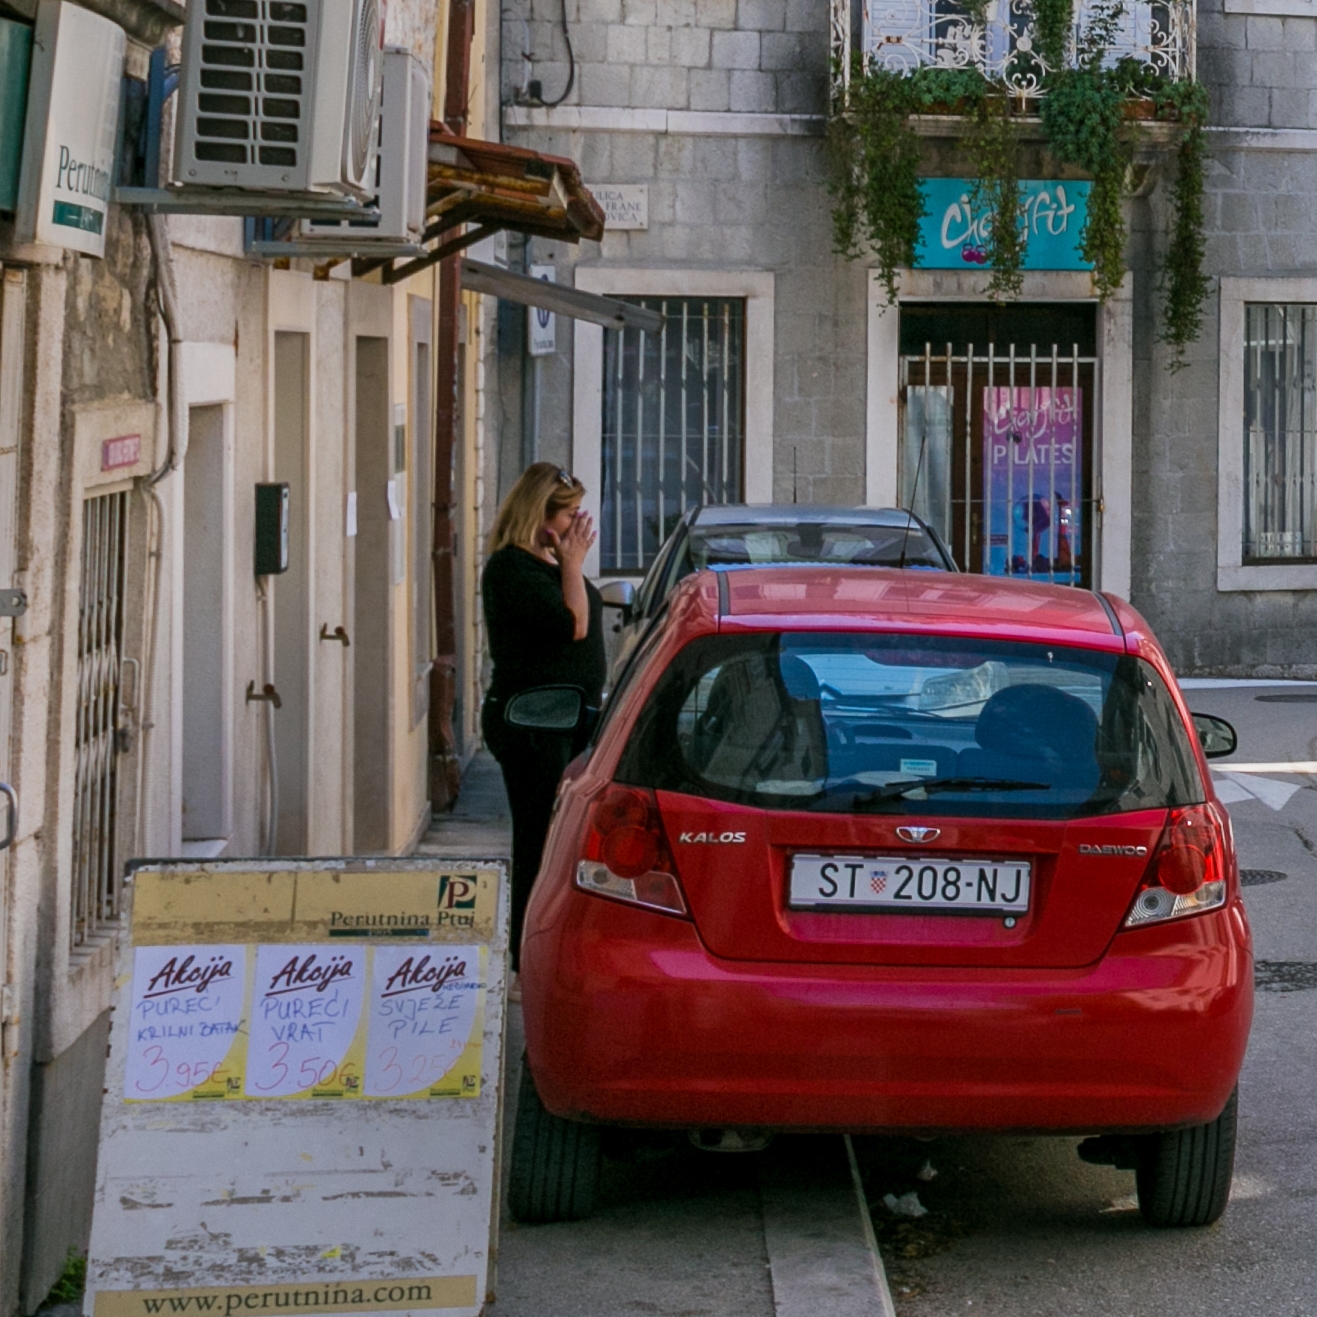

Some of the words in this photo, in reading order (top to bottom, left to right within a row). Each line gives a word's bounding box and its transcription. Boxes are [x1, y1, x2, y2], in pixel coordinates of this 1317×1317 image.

[680, 832, 746, 843] KALOS
[1080, 844, 1147, 856] DAEWOO
[819, 862, 864, 898] ST
[893, 865, 1022, 903] 208-NJ
[330, 911, 430, 927] Perutnina
[437, 910, 475, 928] Ptuj
[143, 954, 233, 998] Akcija
[265, 953, 355, 997] Akcija
[381, 954, 467, 997] Akcija
[271, 1021, 336, 1043] VRAT
[388, 1016, 459, 1040] PILE
[143, 1284, 432, 1316] www.perutnina.com
